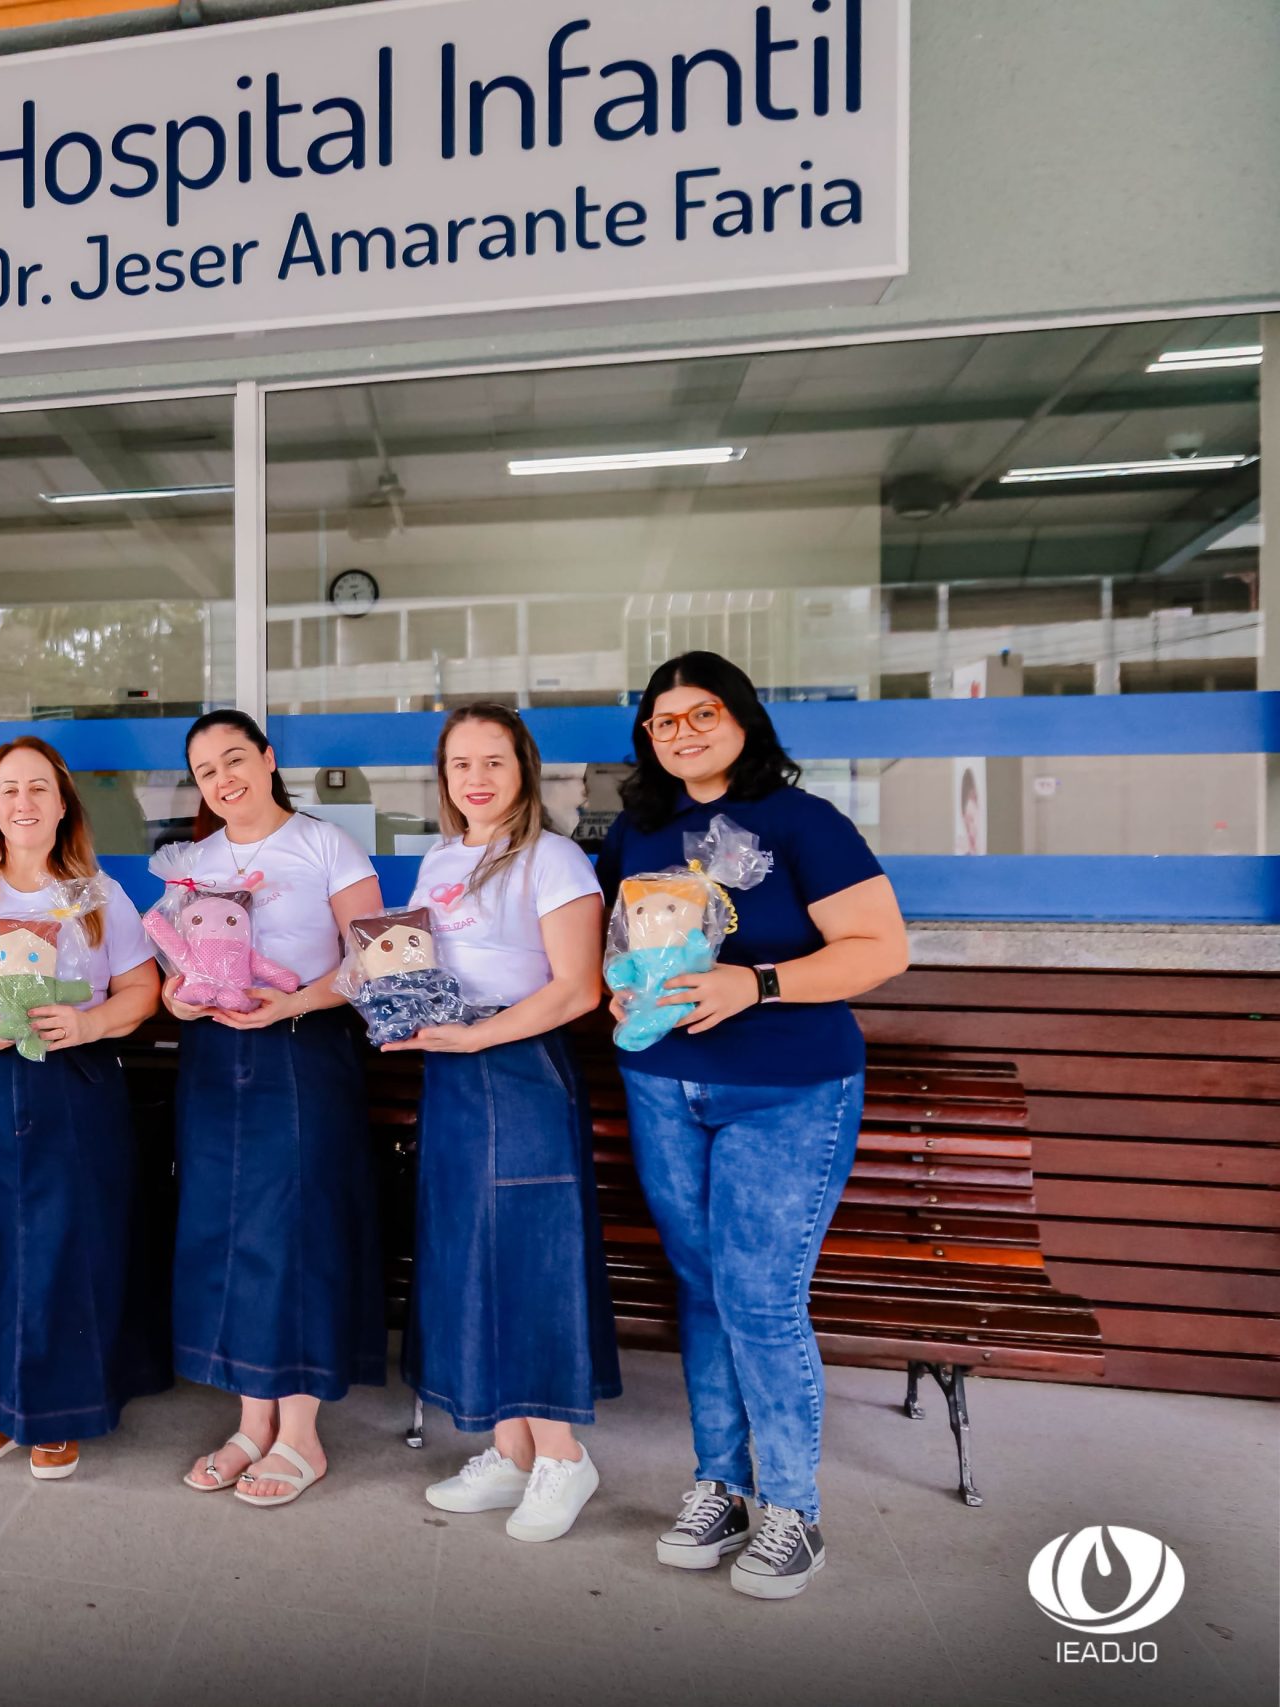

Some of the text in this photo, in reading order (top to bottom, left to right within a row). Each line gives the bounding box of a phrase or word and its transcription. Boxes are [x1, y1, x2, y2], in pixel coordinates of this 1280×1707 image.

[441, 0, 862, 160] Infantil
[70, 234, 260, 301] Jeser
[277, 185, 647, 281] Amarante
[675, 160, 862, 241] Faria
